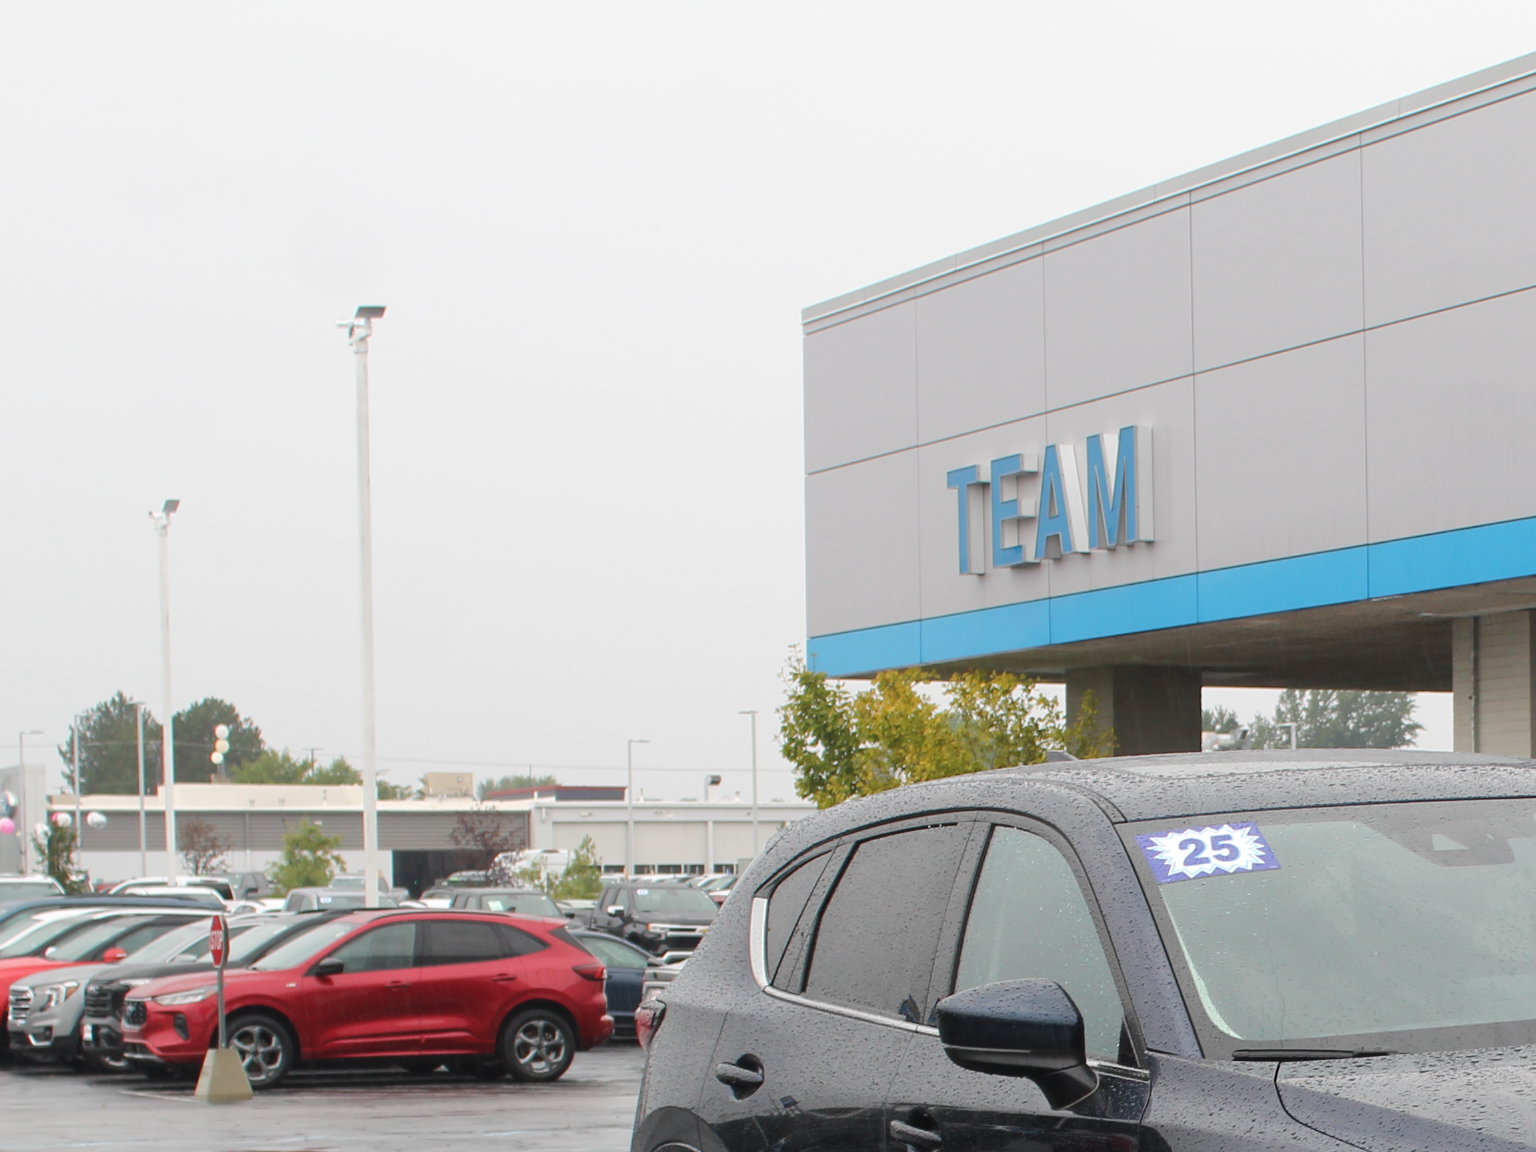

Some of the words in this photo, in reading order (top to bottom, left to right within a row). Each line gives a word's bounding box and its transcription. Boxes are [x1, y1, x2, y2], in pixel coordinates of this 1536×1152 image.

[946, 424, 1147, 575] TEAM
[1178, 833, 1241, 867] 25
[210, 930, 224, 950] STOP
